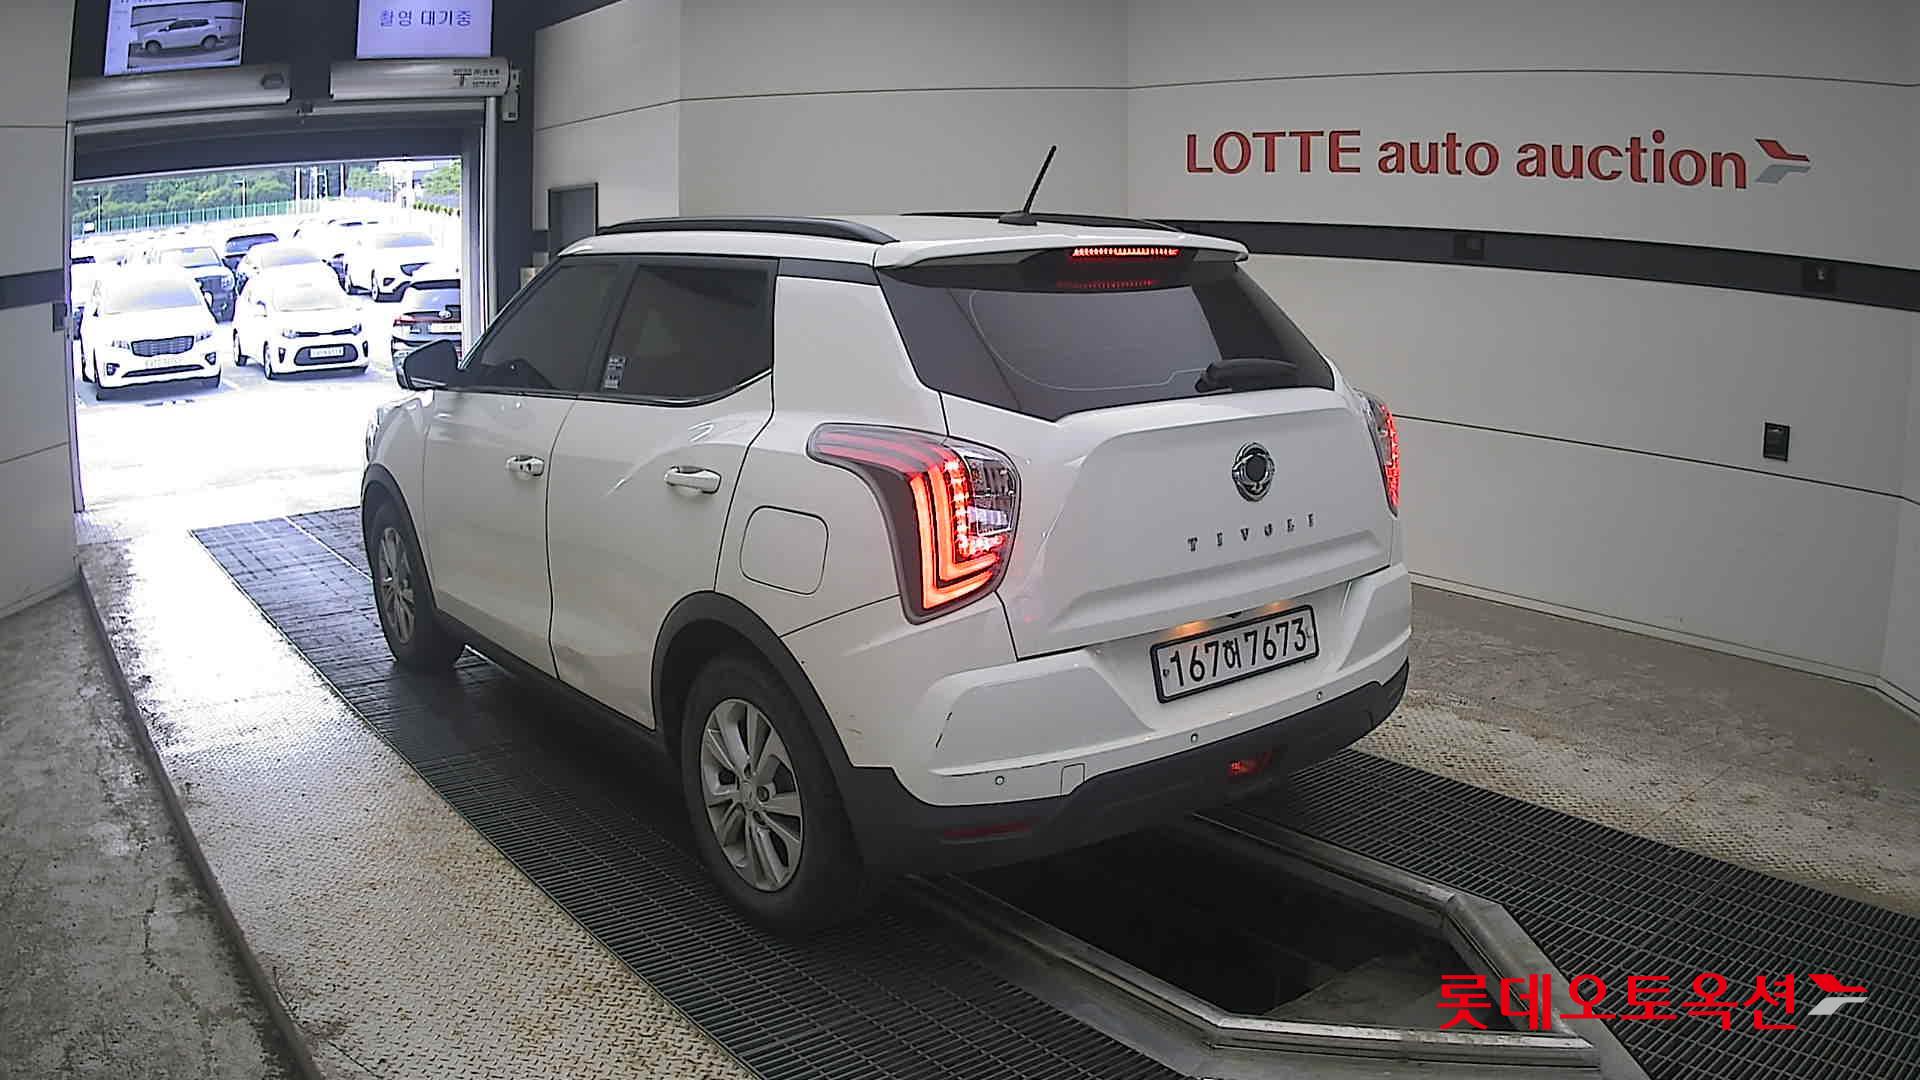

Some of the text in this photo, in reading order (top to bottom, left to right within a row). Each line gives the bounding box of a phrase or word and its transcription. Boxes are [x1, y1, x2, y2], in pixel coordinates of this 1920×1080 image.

[421, 10, 472, 27] 대기중
[1186, 129, 1747, 189] LOTTE auto auction
[1187, 513, 1316, 552] TIVOLI
[1170, 618, 1307, 687] 167허7673
